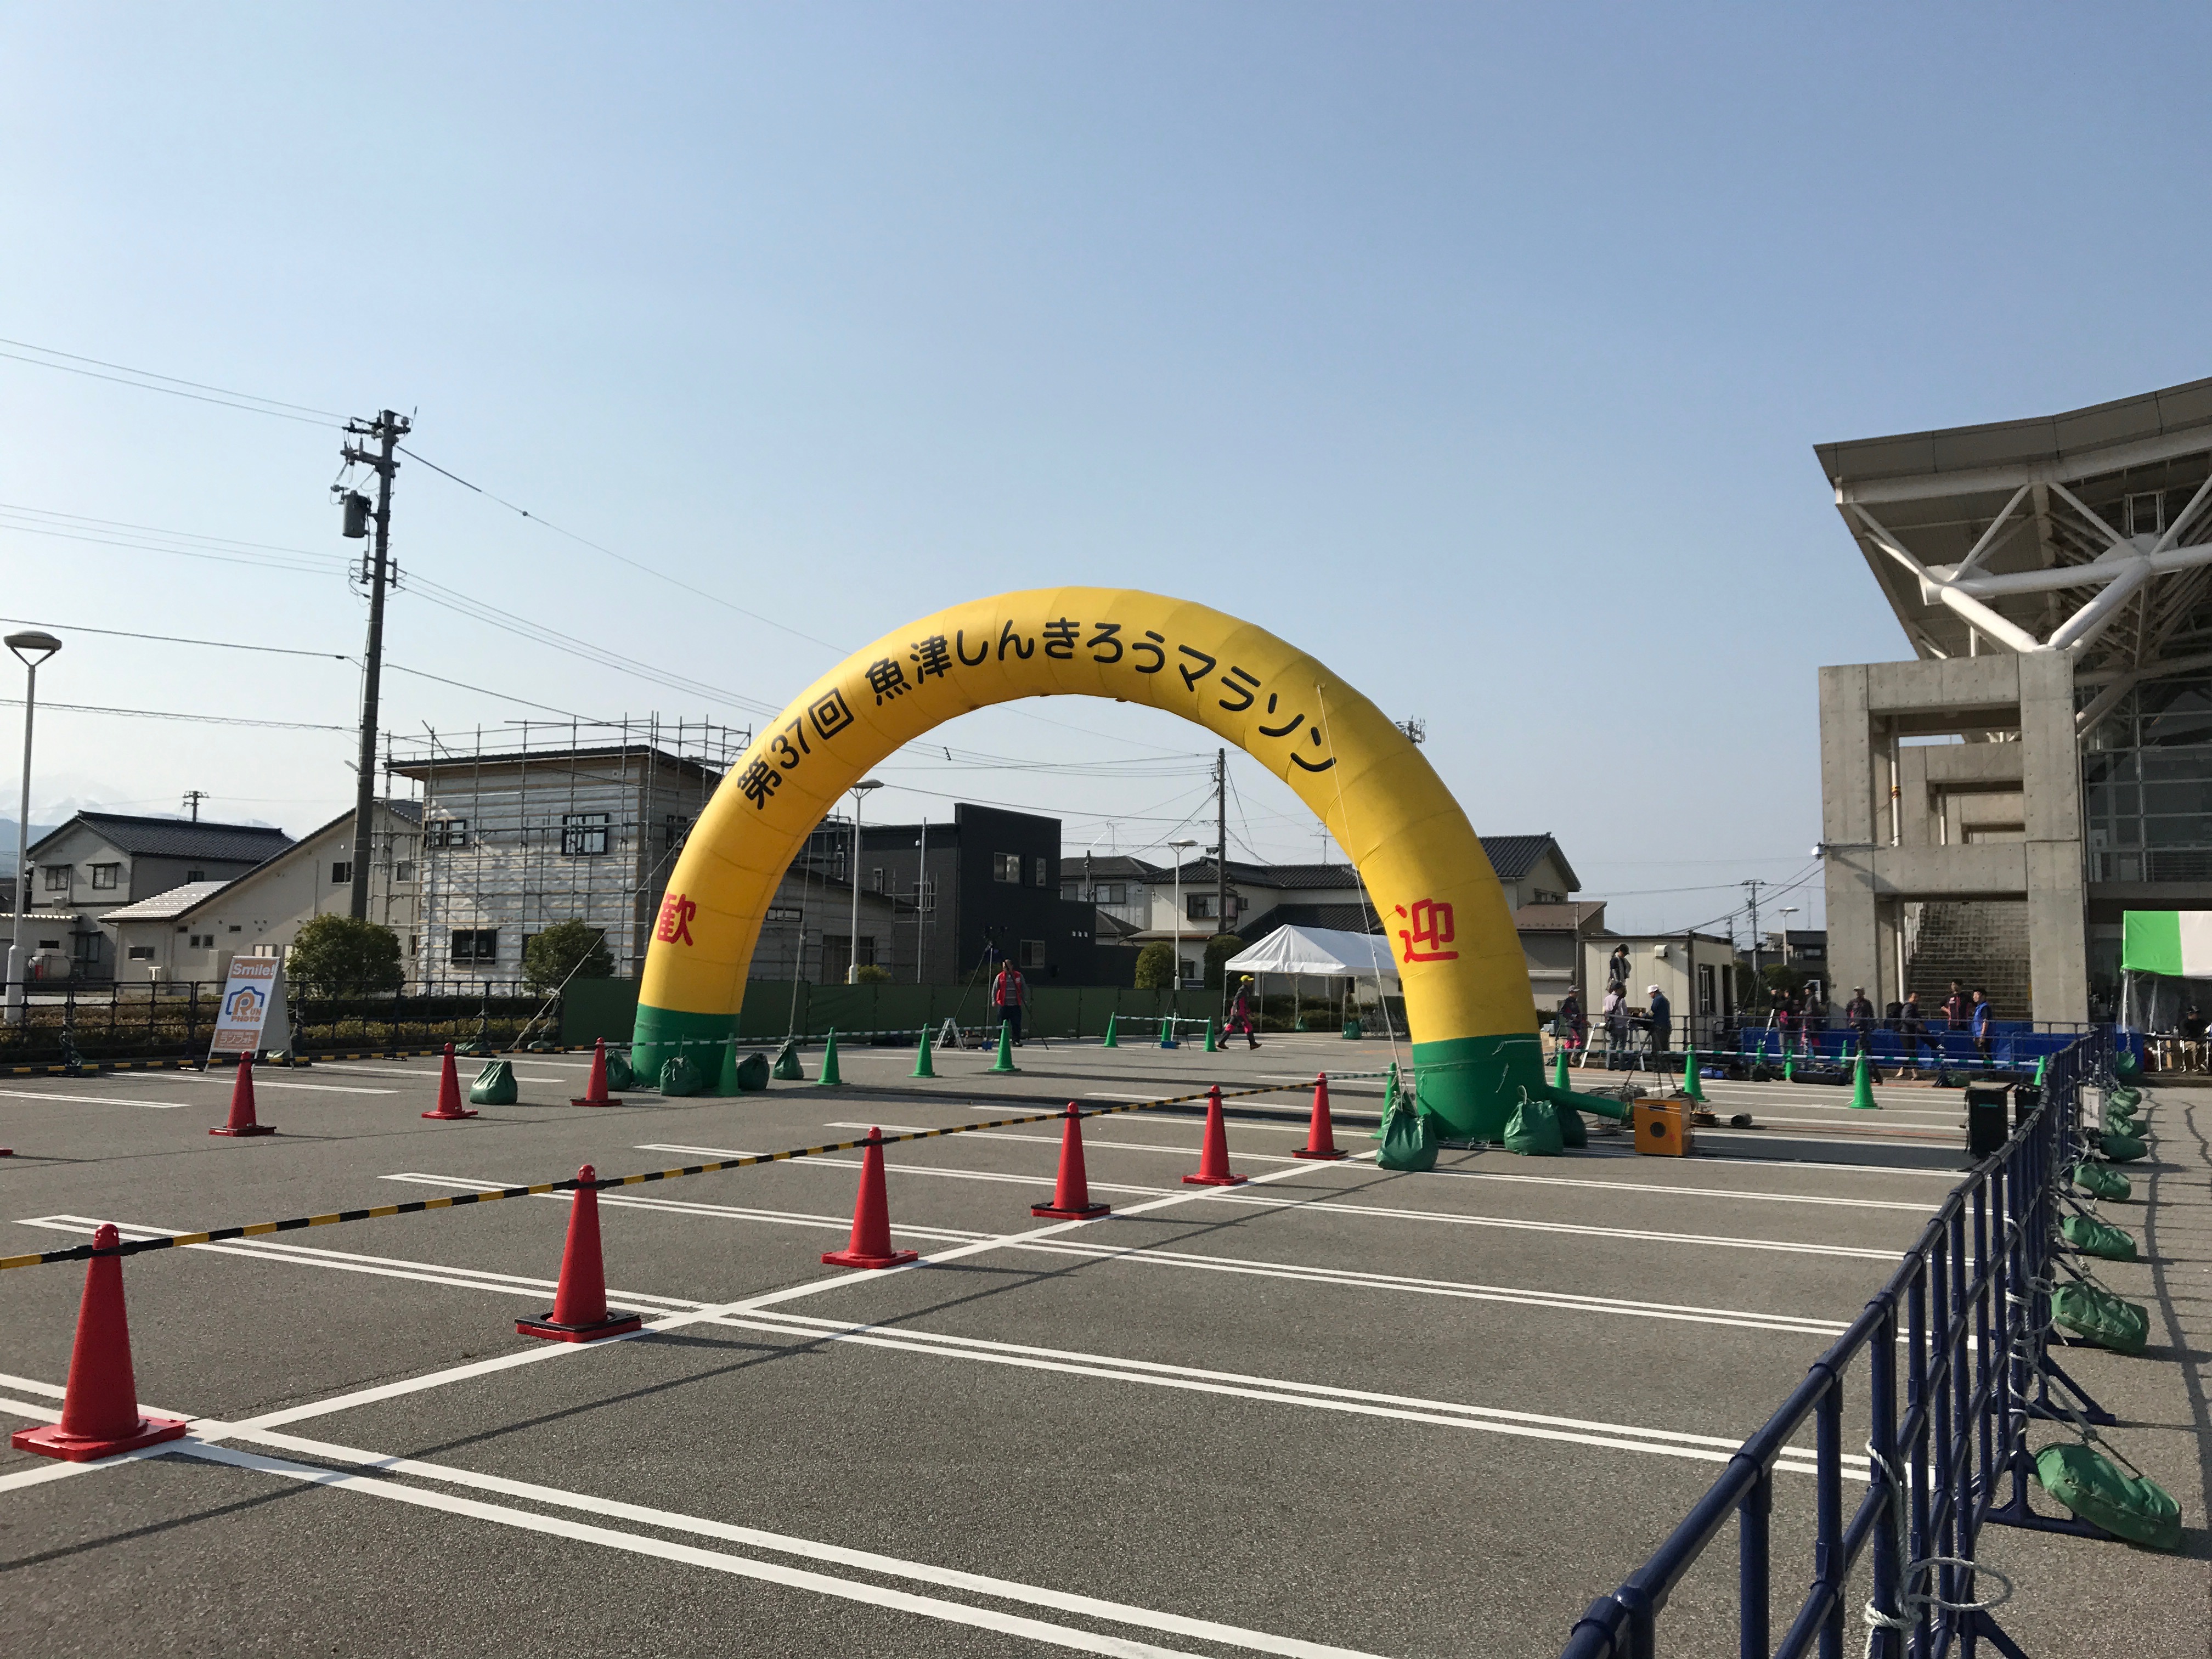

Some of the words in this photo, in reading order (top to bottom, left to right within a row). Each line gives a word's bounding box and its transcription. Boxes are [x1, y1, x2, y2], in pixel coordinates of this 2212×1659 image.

[736, 687, 855, 810] 第37回
[865, 617, 1337, 772] 魚津しんきろうマラソン
[657, 890, 697, 947] 歓
[1395, 898, 1459, 964] 迎
[233, 963, 275, 976] Smile!
